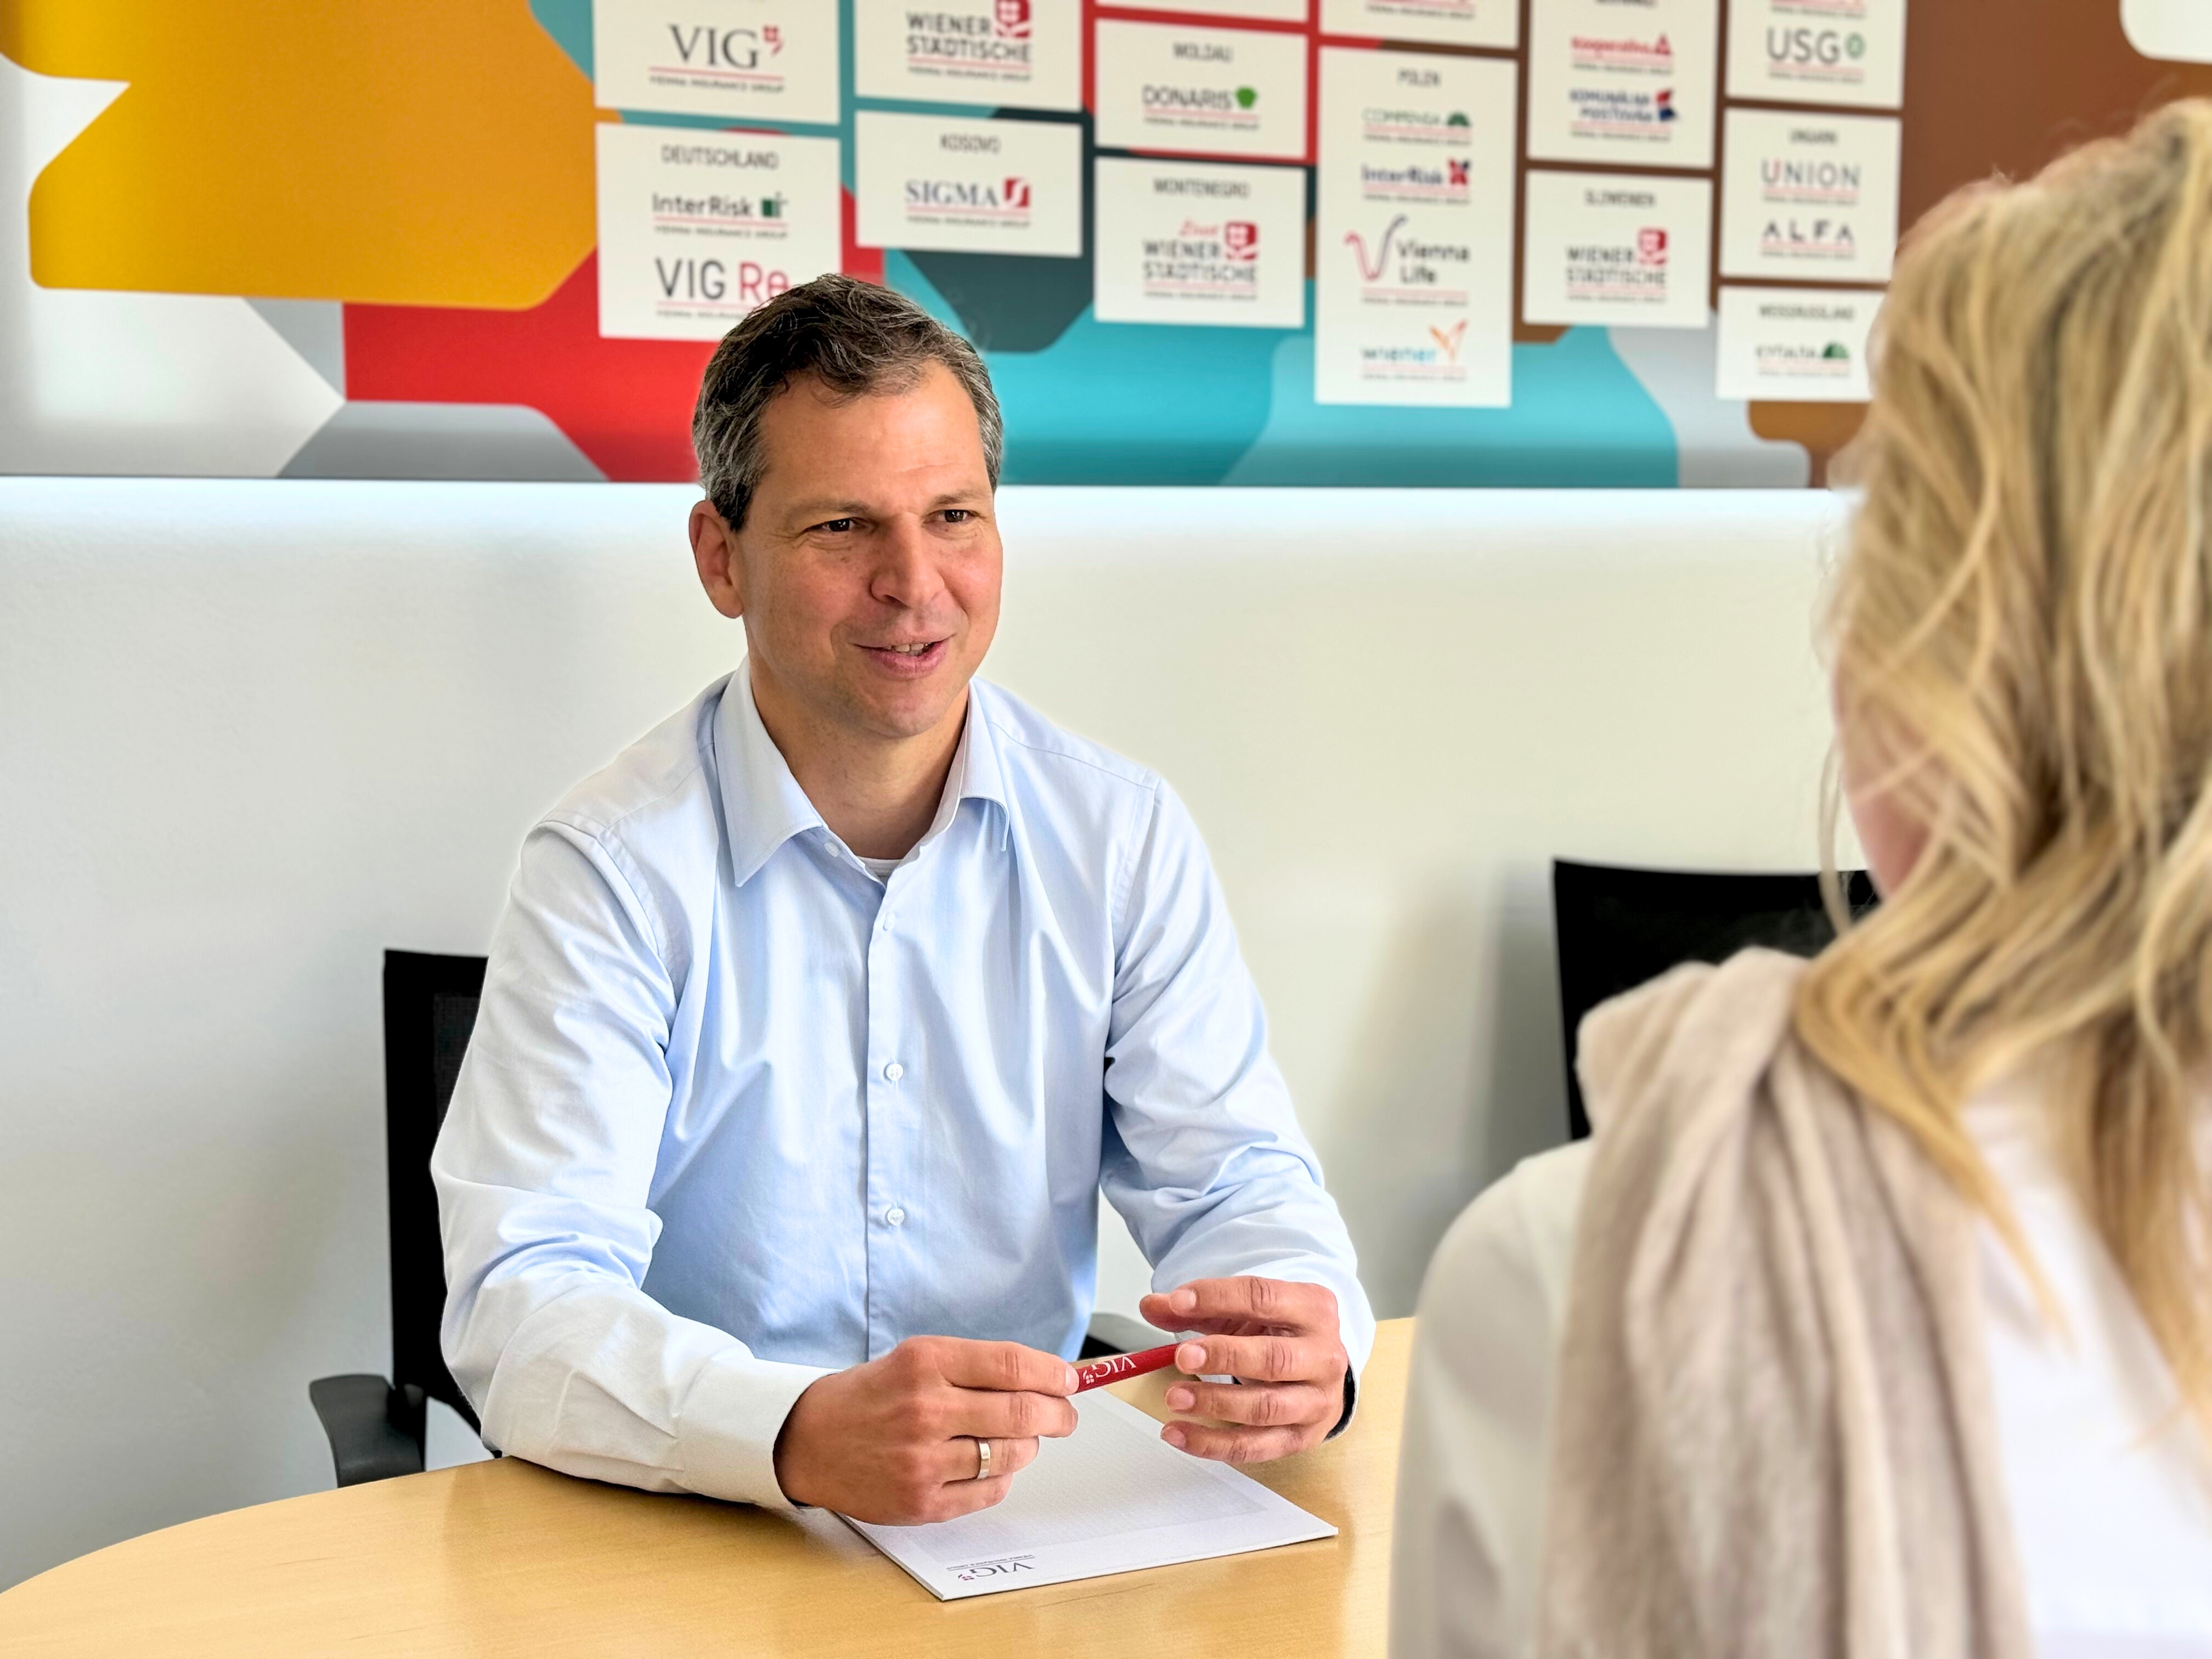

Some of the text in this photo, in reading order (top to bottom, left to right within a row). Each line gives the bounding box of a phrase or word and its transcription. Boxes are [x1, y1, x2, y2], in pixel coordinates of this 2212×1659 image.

[906, 12, 991, 36] WIENER
[668, 24, 759, 69] VIG
[906, 35, 1031, 63] STÄDTISCHE
[1767, 27, 1841, 64] USG
[1142, 84, 1233, 110] DONARIS
[939, 133, 1002, 154] KOSOVO
[661, 144, 779, 170] DEUTSCHLAND
[1762, 160, 1861, 188] UNION
[652, 193, 752, 218] InterRisk
[905, 180, 999, 207] SIGMA
[1763, 219, 1854, 241] ALFA
[1143, 240, 1221, 259] WIENER
[655, 257, 726, 300] VIG
[1091, 1356, 1136, 1378] VIG
[969, 1562, 1035, 1577] VIG
